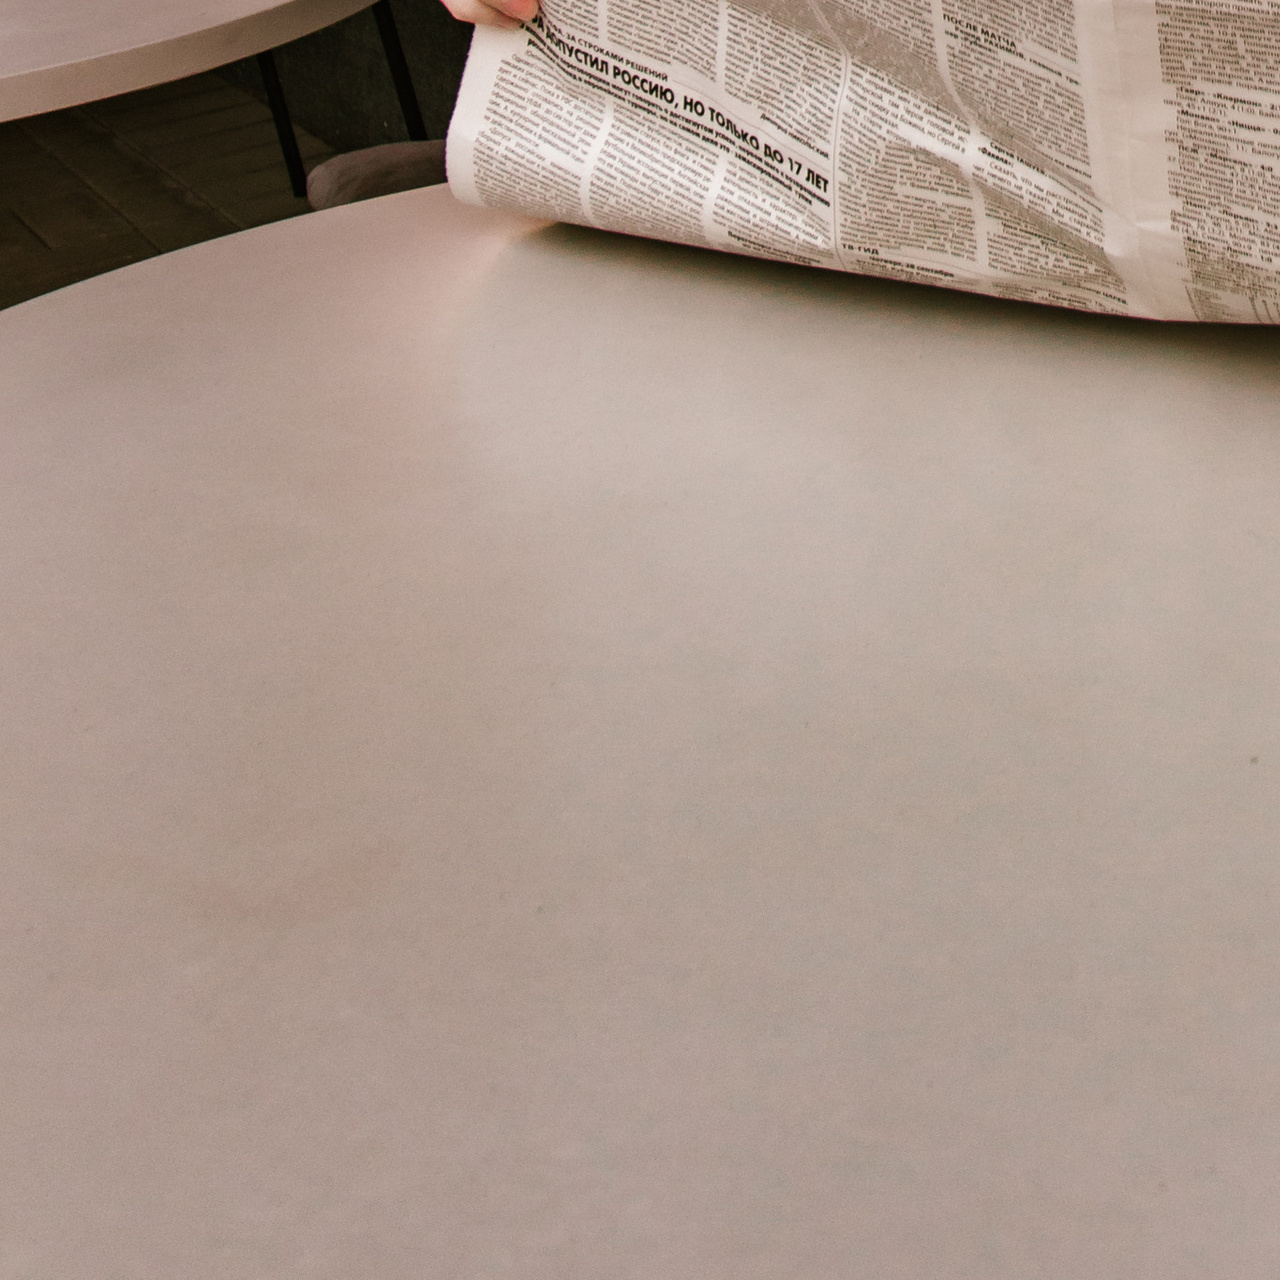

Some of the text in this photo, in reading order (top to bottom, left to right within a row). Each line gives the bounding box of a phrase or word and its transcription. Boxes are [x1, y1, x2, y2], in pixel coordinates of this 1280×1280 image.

[612, 64, 680, 110] РОССИЮ,
[683, 95, 706, 118] НО
[708, 105, 761, 151] ТОЛЬКО
[763, 142, 785, 165] ДО
[787, 156, 803, 176] 17
[804, 167, 830, 194] ЛЕТ
